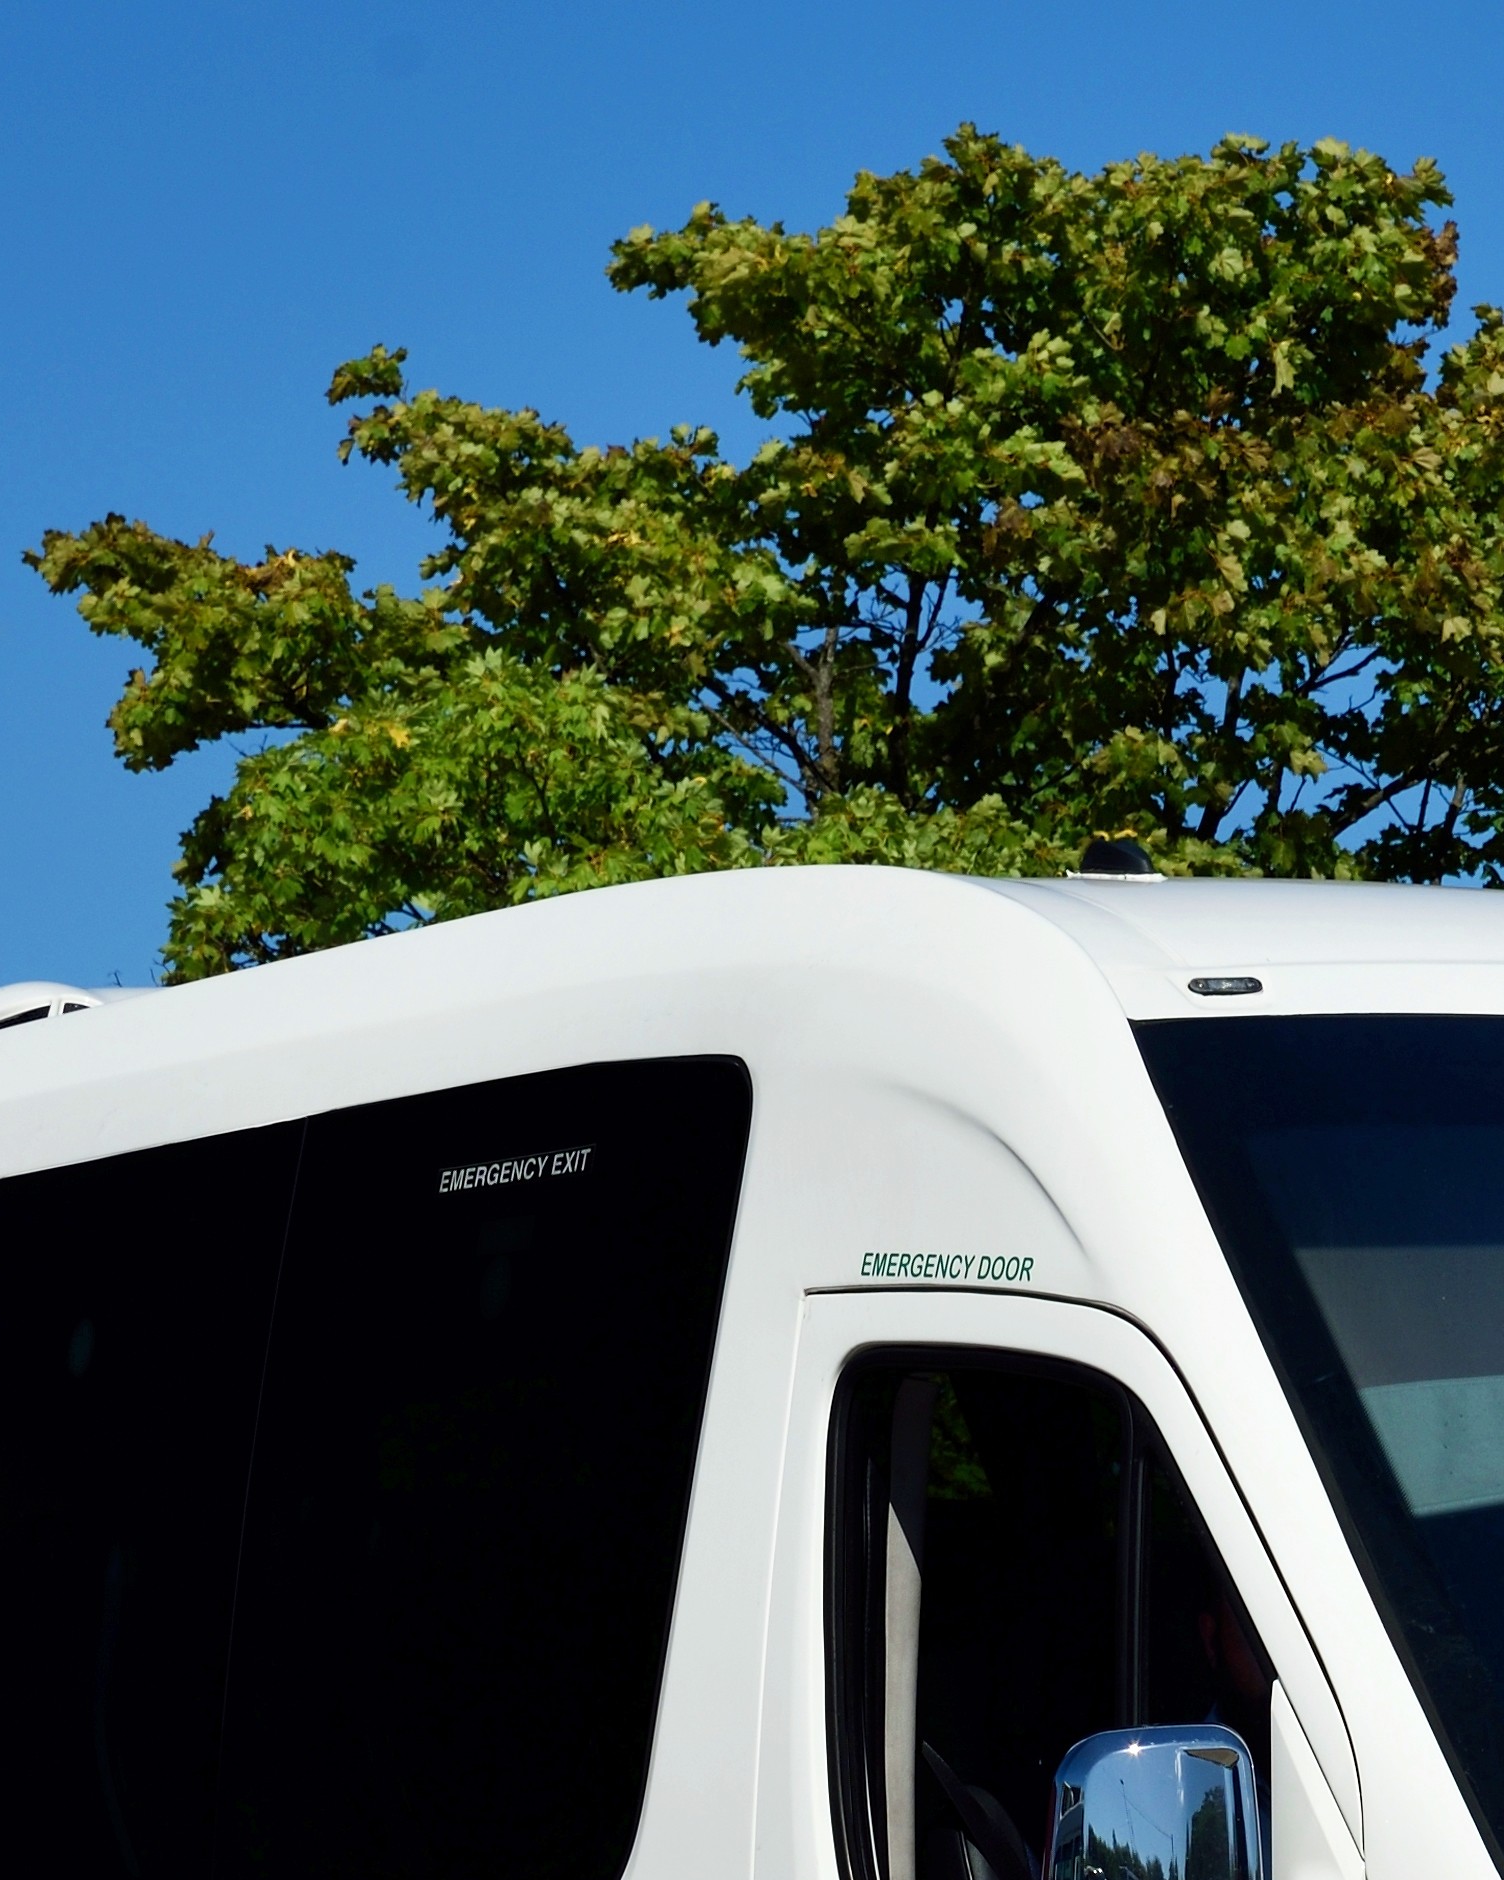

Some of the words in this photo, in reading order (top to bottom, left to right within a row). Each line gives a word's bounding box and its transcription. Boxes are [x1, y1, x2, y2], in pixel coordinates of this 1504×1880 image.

[439, 1155, 549, 1193] EMERGENCY
[551, 1148, 592, 1176] EXIT
[860, 1252, 976, 1280] EMERGENCY
[977, 1255, 1034, 1282] DOOR
